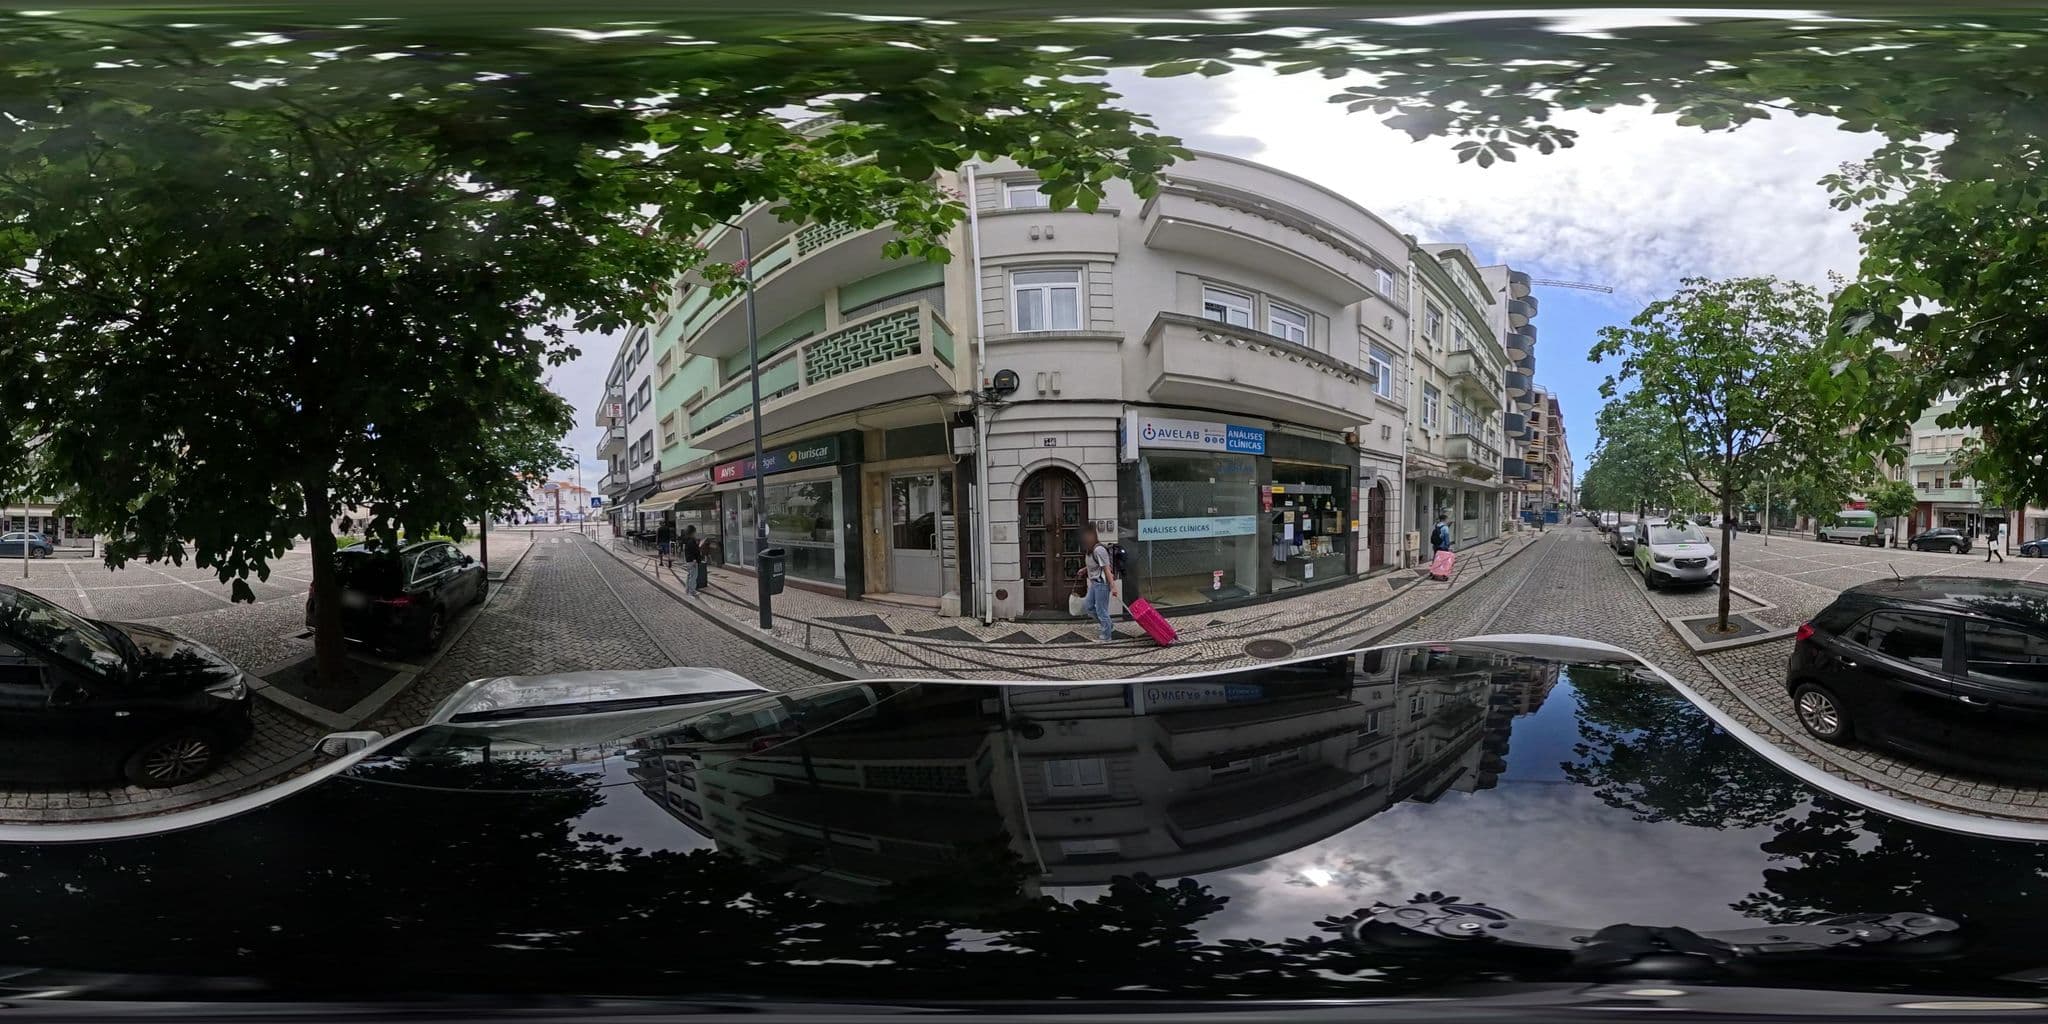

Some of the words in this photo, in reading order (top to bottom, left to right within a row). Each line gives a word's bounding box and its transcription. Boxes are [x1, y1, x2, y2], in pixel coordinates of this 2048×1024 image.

[1158, 428, 1200, 440] AVELAB
[1228, 429, 1263, 441] ANÁLISES
[1229, 439, 1262, 450] CLÍNICAS
[798, 446, 829, 461] turiscar
[720, 466, 735, 478] AVIS
[1142, 525, 1178, 534] ANÁLISES
[1179, 524, 1210, 533] CLÍNICAS
